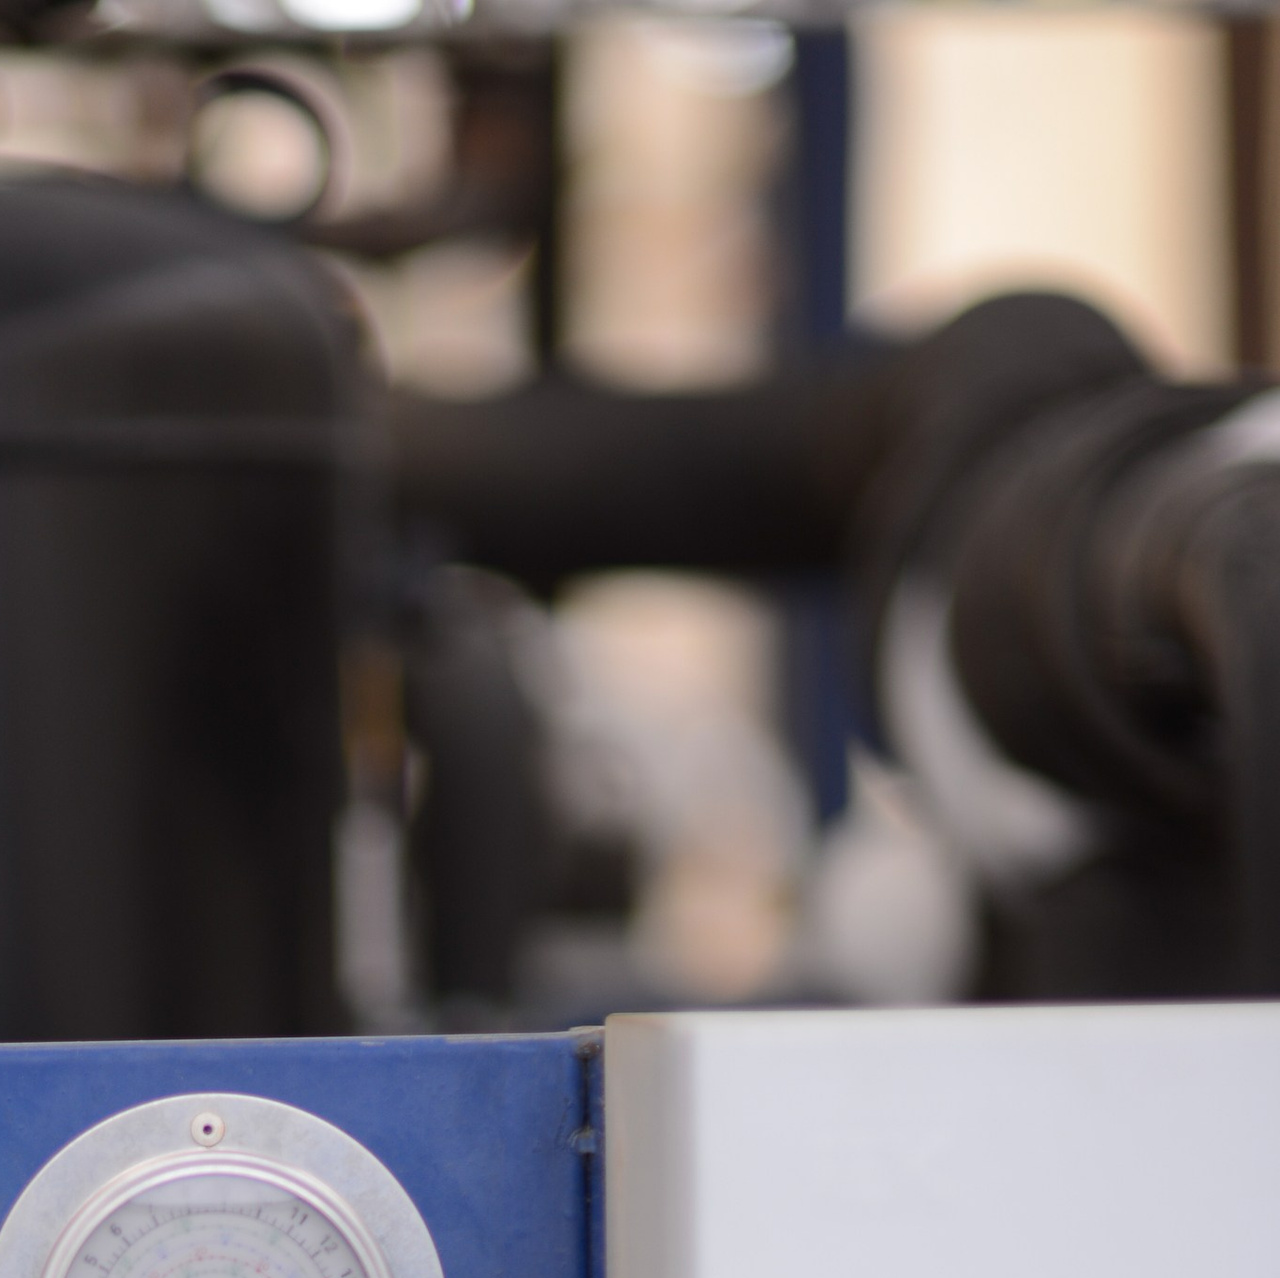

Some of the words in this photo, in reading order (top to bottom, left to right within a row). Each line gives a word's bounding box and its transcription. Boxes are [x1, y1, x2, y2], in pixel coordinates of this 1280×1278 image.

[289, 1206, 309, 1225] 11
[109, 1222, 123, 1237] 6
[320, 1233, 339, 1253] 12
[83, 1253, 98, 1267] 5
